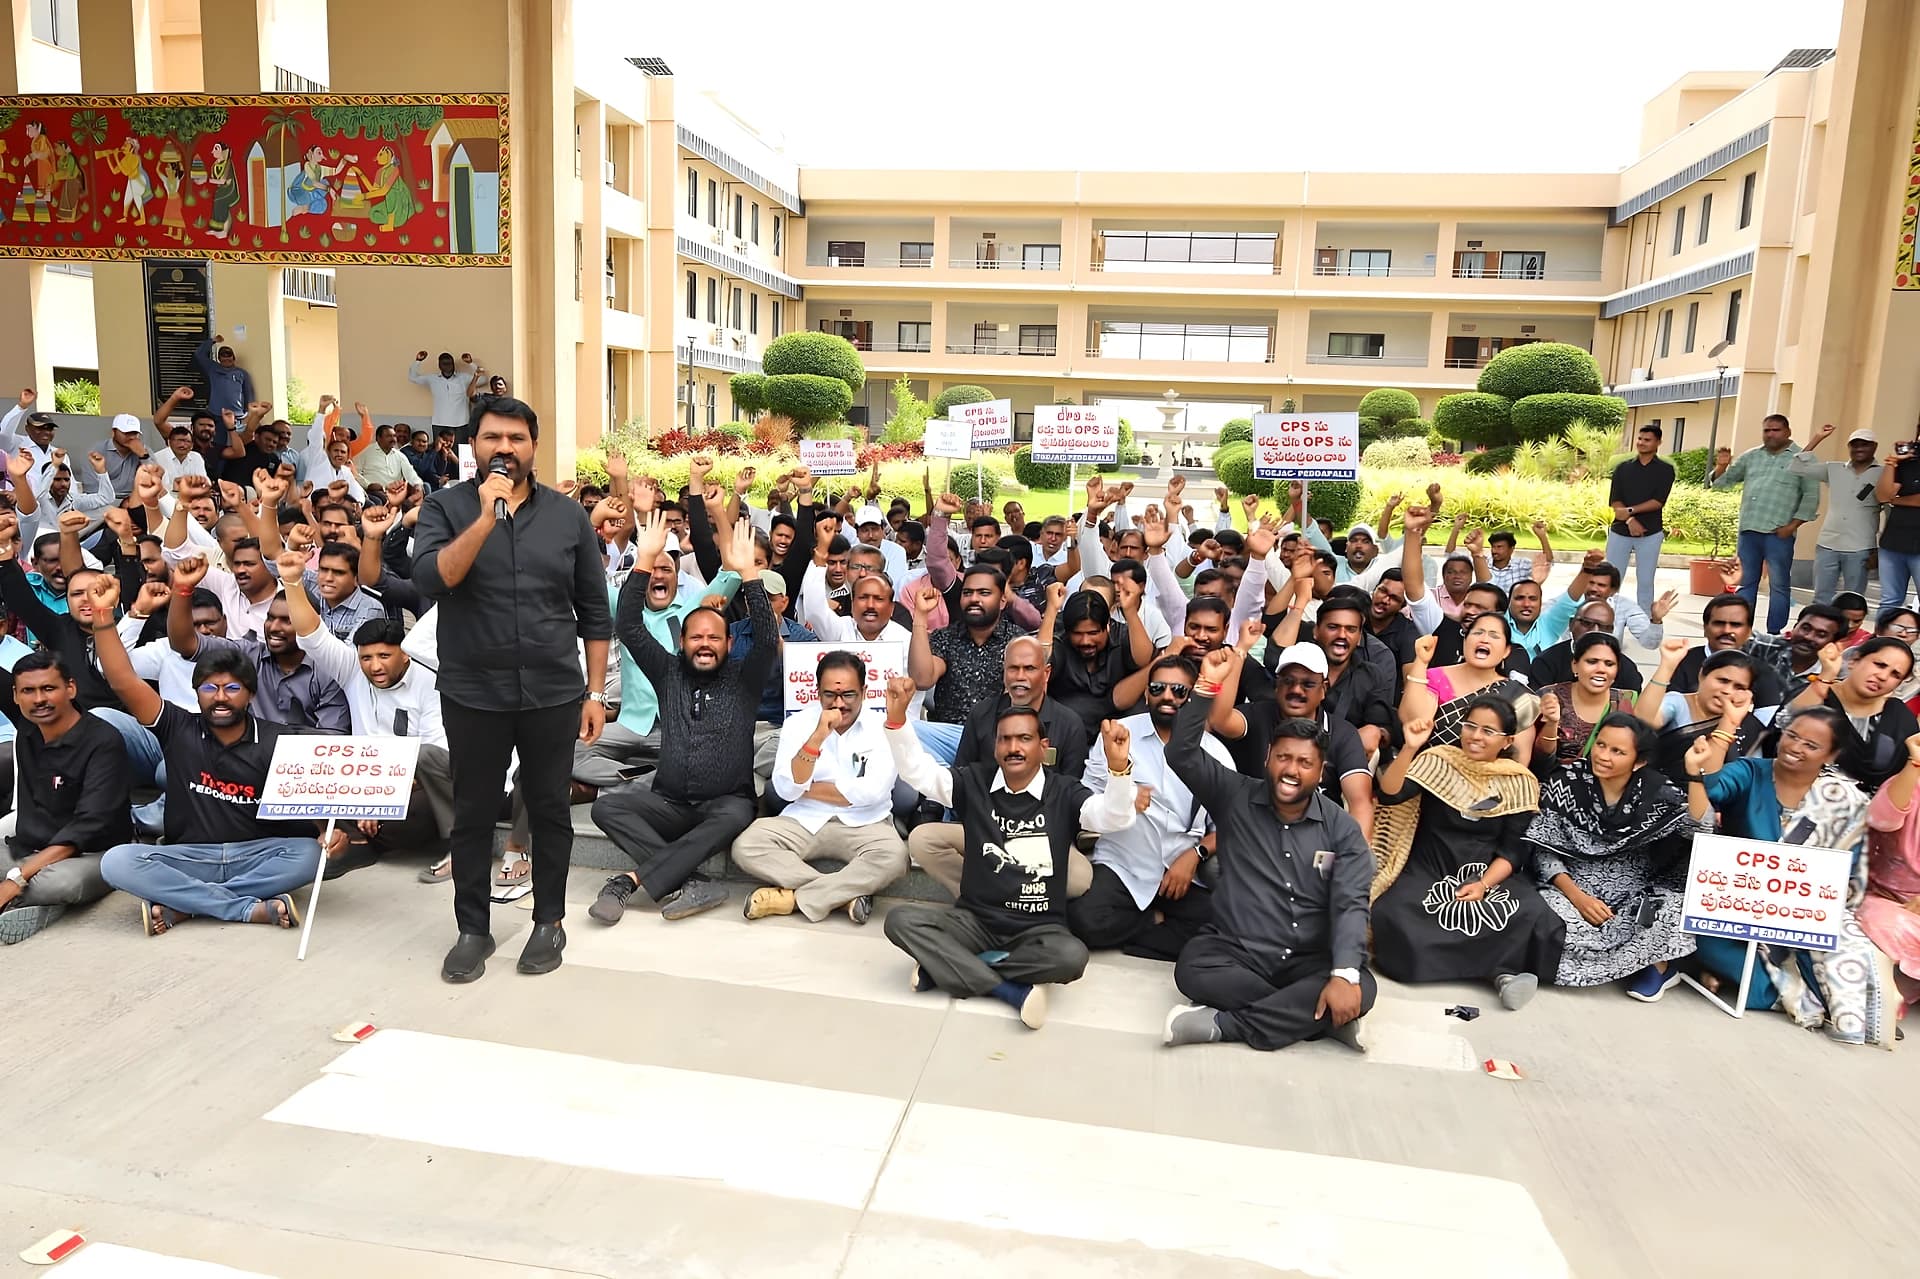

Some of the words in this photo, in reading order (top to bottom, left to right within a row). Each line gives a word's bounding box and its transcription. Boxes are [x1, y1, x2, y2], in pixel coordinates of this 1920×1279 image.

[1075, 425, 1099, 434] OPS
[1280, 421, 1310, 432] CPS
[1303, 436, 1334, 447] OPS
[1297, 470, 1353, 478] PEDDAPALLI
[313, 745, 354, 758] CPS
[360, 745, 379, 758] ను
[340, 763, 382, 776] OPS
[388, 763, 407, 777] ను
[189, 781, 262, 805] PEDDAPALLY
[321, 805, 400, 816] PEDDAPALLI
[1736, 851, 1780, 870] CPS
[1787, 858, 1808, 873] ను
[1696, 869, 1729, 892] రద్దు
[1733, 872, 1761, 891] చేసి
[1766, 878, 1812, 897] OPS
[1818, 884, 1839, 900] ను
[1004, 901, 1049, 913] CHICAGO
[1749, 928, 1833, 947] PEDDAPALLI
